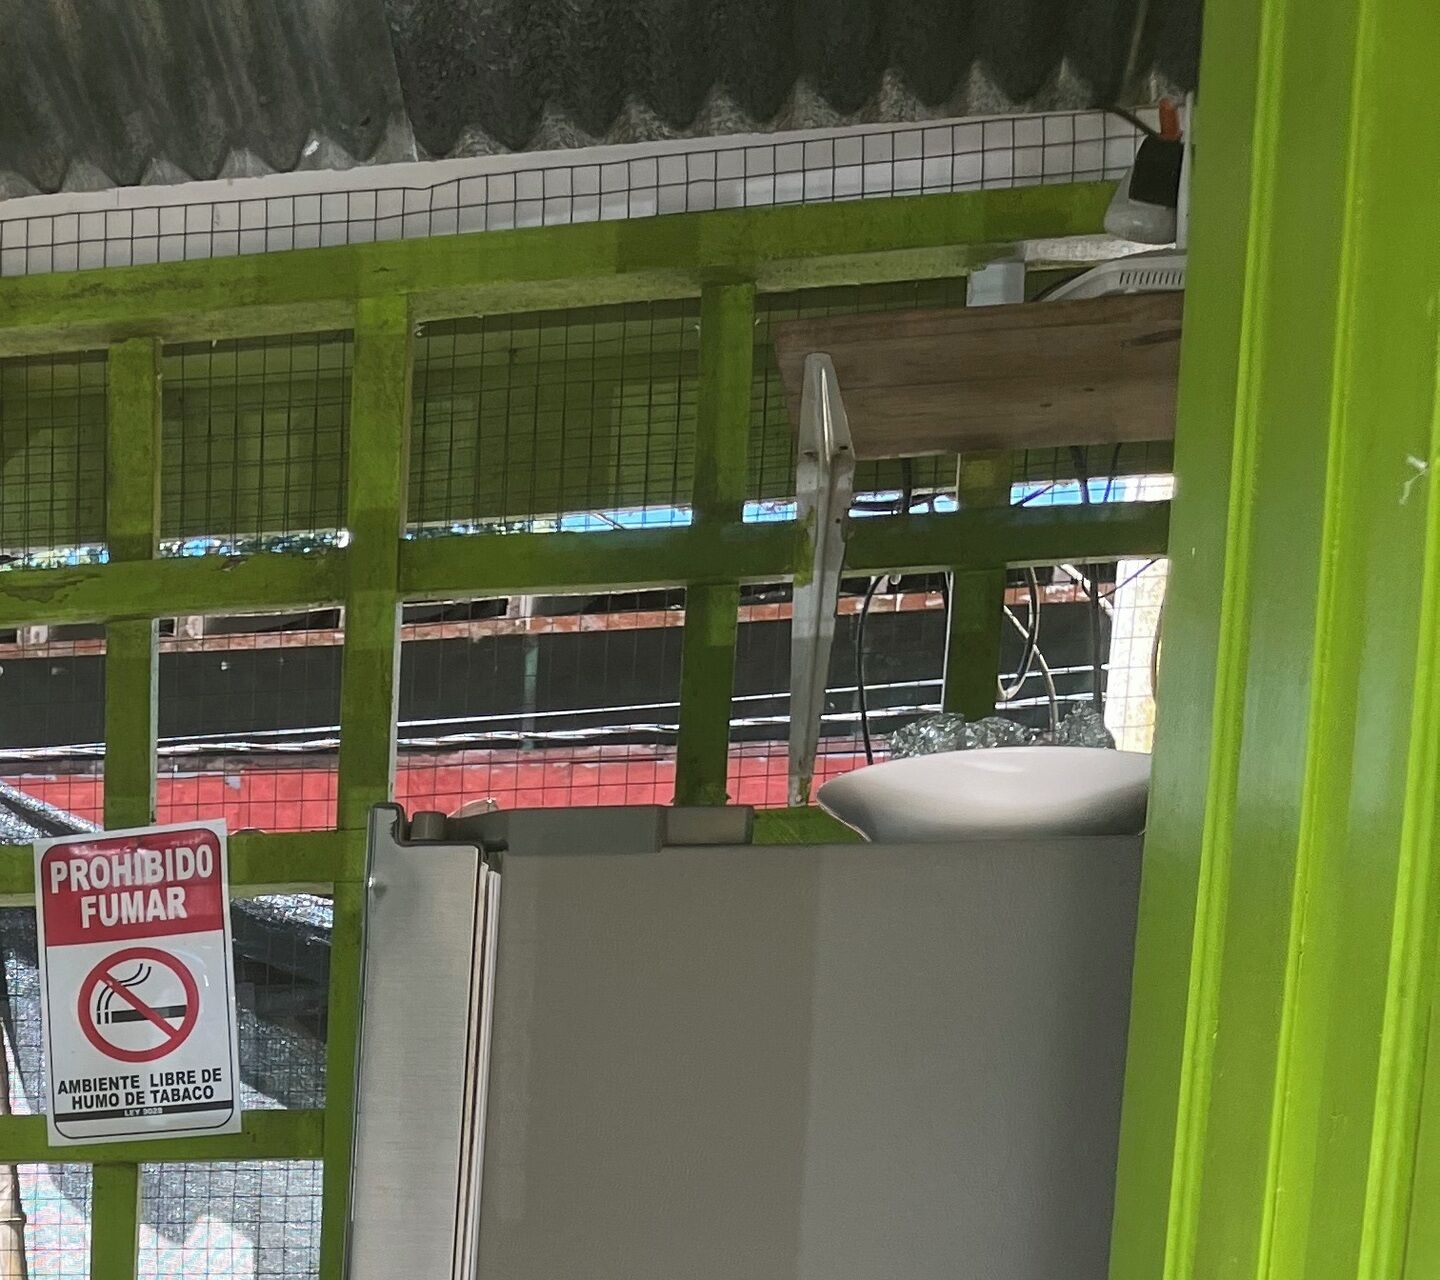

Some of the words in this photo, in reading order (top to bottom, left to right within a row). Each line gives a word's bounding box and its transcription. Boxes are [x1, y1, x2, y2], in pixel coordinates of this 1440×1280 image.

[50, 844, 212, 894] PROHIBIDO
[81, 886, 187, 928] FUMAR
[58, 1075, 140, 1094] AMBIENTE
[150, 1070, 196, 1088] LIBRE
[201, 1067, 222, 1083] DE
[72, 1093, 120, 1110] HUMO
[125, 1091, 145, 1106] DE
[150, 1085, 214, 1104] TABACO
[124, 1108, 141, 1117] LEY
